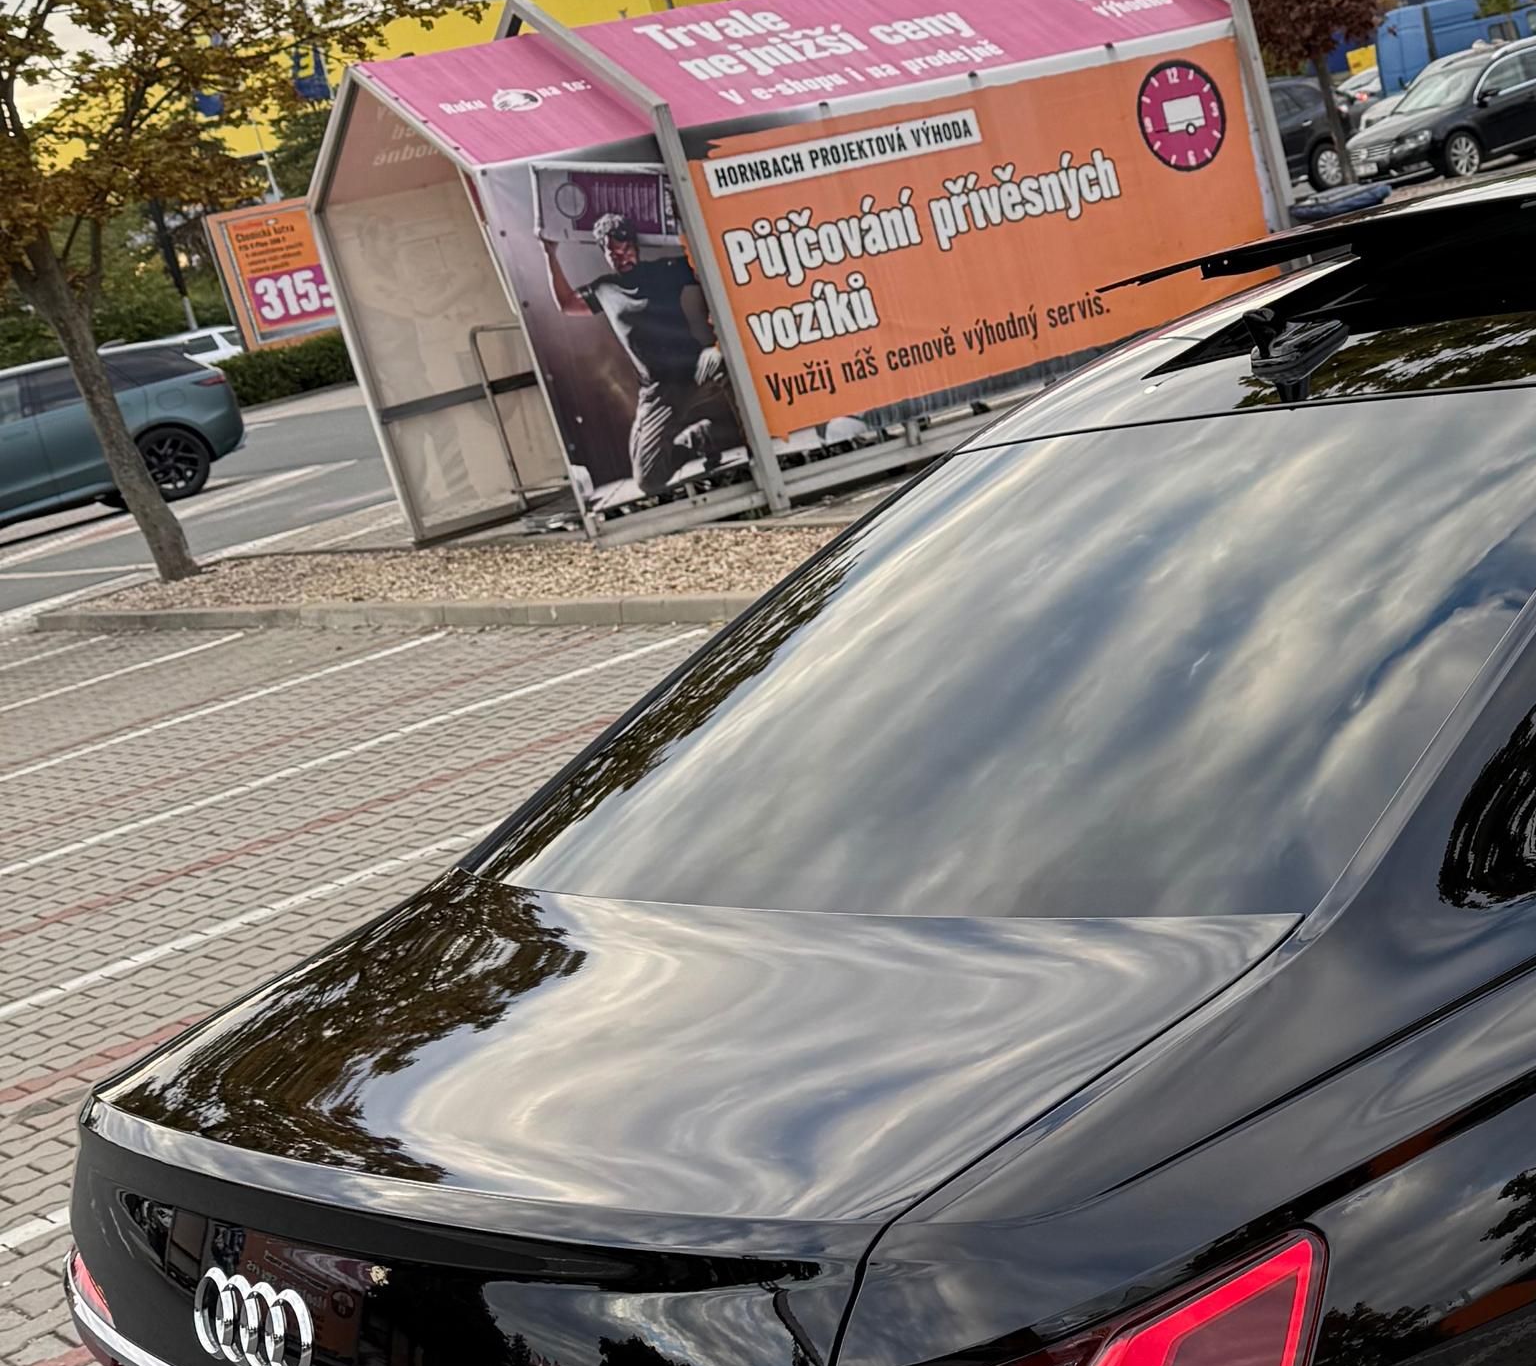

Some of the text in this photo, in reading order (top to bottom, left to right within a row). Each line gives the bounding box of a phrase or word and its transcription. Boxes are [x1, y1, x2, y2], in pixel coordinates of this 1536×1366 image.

[633, 9, 791, 51] Trvale
[679, 11, 977, 82] nejnižší ceny
[439, 78, 592, 115] Ruku na to:
[750, 73, 848, 102] e-shopu
[848, 65, 866, 82] i
[865, 61, 900, 78] na
[899, 39, 1004, 75] prodejně
[714, 117, 973, 189] HORNBACH PROJEKTOVÁ VÝHODA
[722, 186, 923, 287] Půjčování
[928, 148, 1122, 253] přívěsných
[747, 270, 880, 354] vozíků
[765, 290, 1112, 406] Využij náš cenově výhodný servis.
